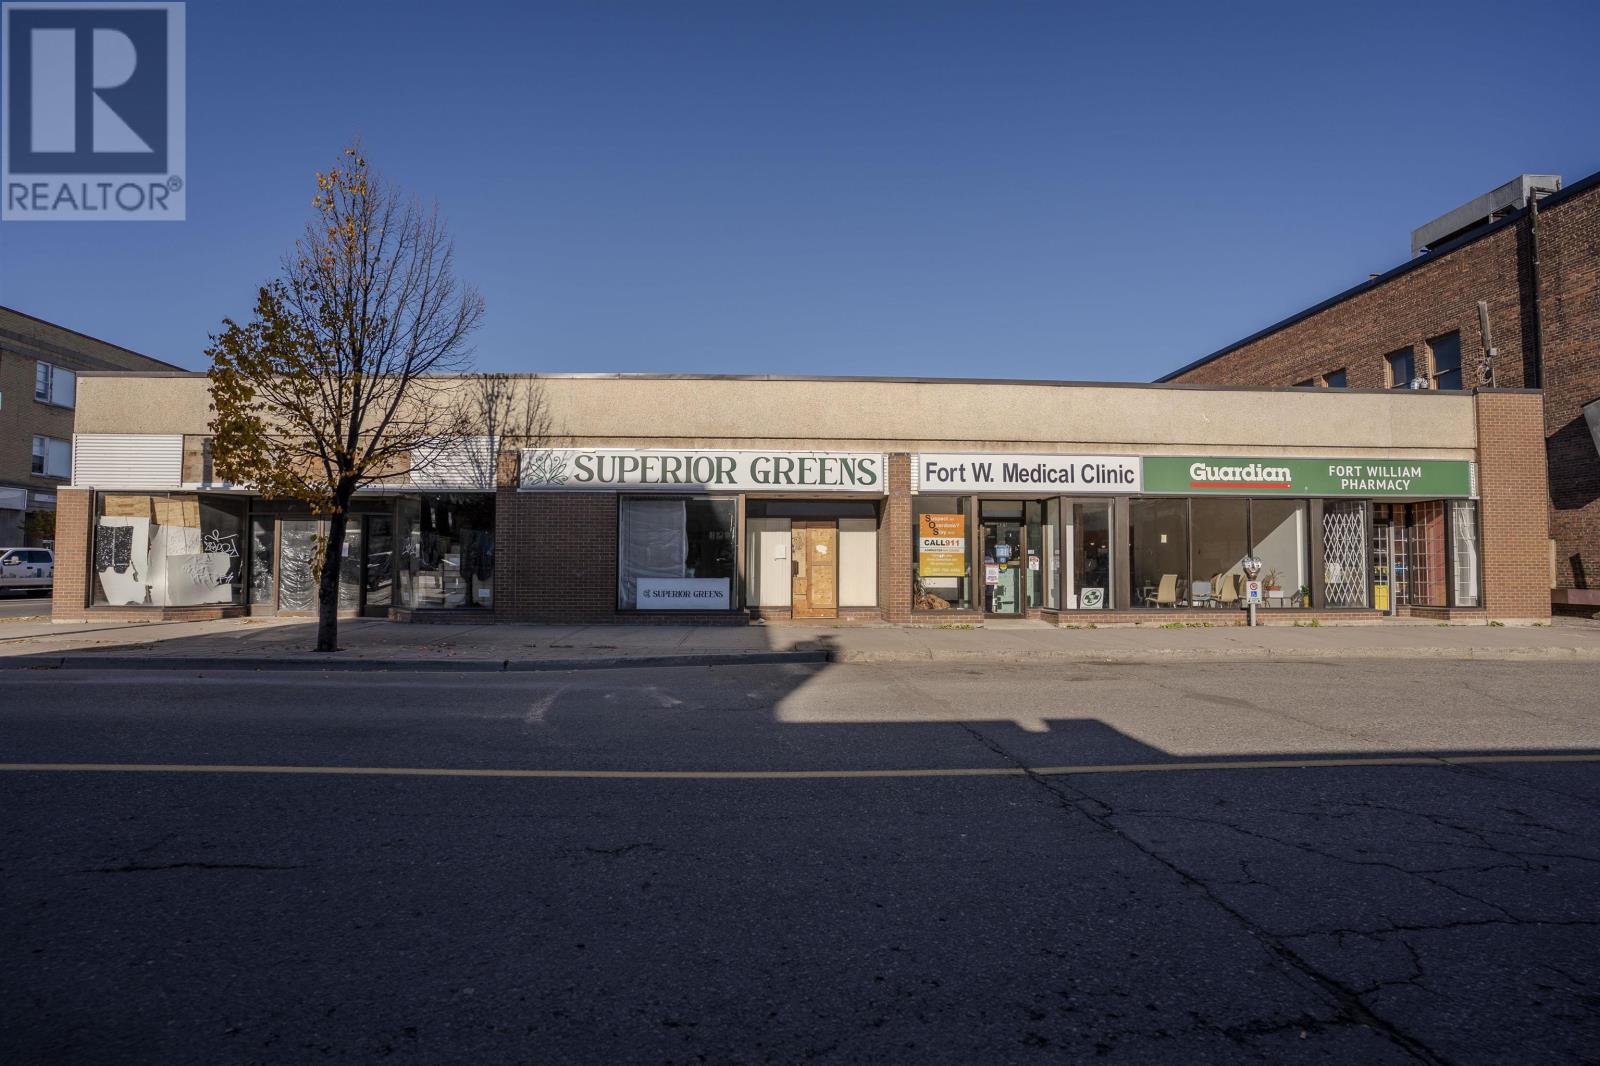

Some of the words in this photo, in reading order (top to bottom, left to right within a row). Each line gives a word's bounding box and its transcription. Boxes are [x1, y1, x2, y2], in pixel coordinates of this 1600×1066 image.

[574, 454, 738, 484] SUPERIOR
[749, 456, 877, 486] GREENS
[926, 461, 966, 483] Fort
[971, 462, 995, 483] W.
[1002, 462, 1075, 484] Medical
[1081, 463, 1135, 484] Clinic
[1190, 462, 1292, 482] Guardian
[1329, 465, 1363, 477] FORT
[1367, 465, 1422, 478] WILLIAM
[1341, 478, 1411, 491] PHARMACY
[652, 590, 691, 598] SUPERIOR
[693, 590, 724, 598] GREENS
